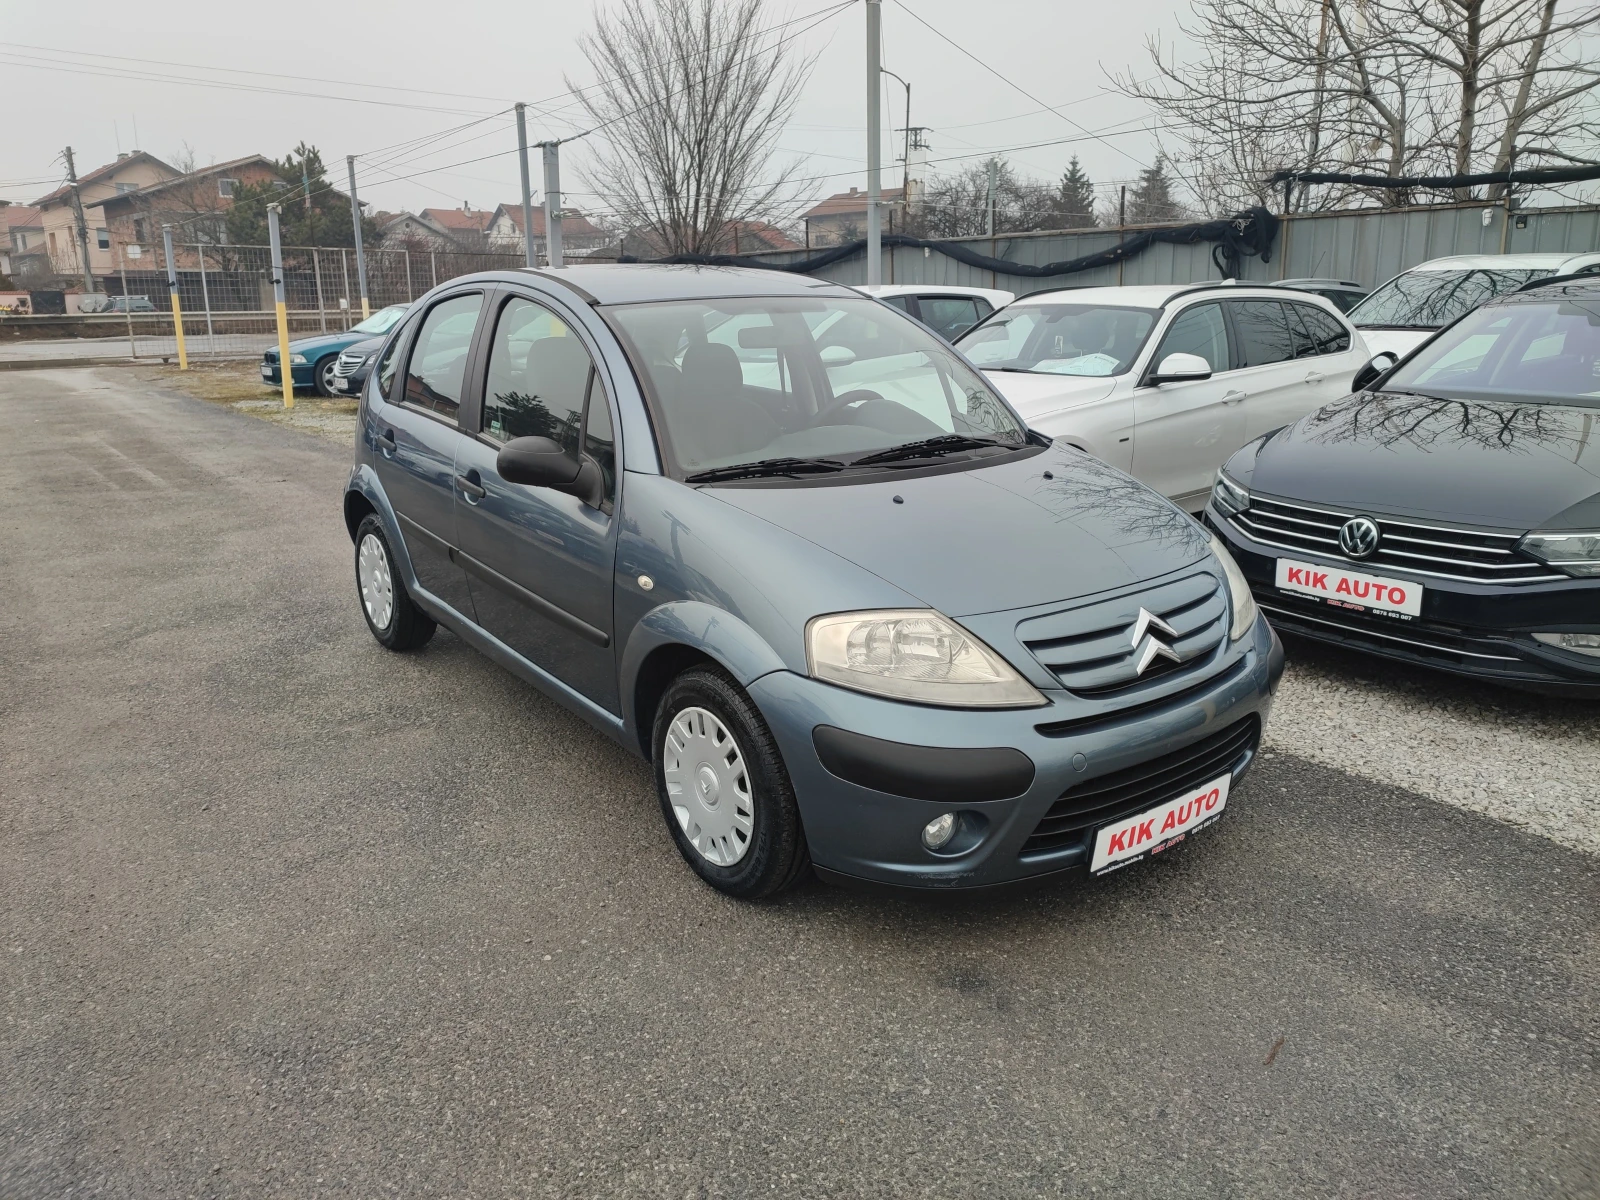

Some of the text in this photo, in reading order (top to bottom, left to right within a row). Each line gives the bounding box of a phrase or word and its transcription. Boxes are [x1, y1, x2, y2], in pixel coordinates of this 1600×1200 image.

[1287, 567, 1406, 605] KIK AUTO
[1107, 788, 1220, 856] KIK AUTO
[1151, 834, 1185, 855] KIK AUTO
